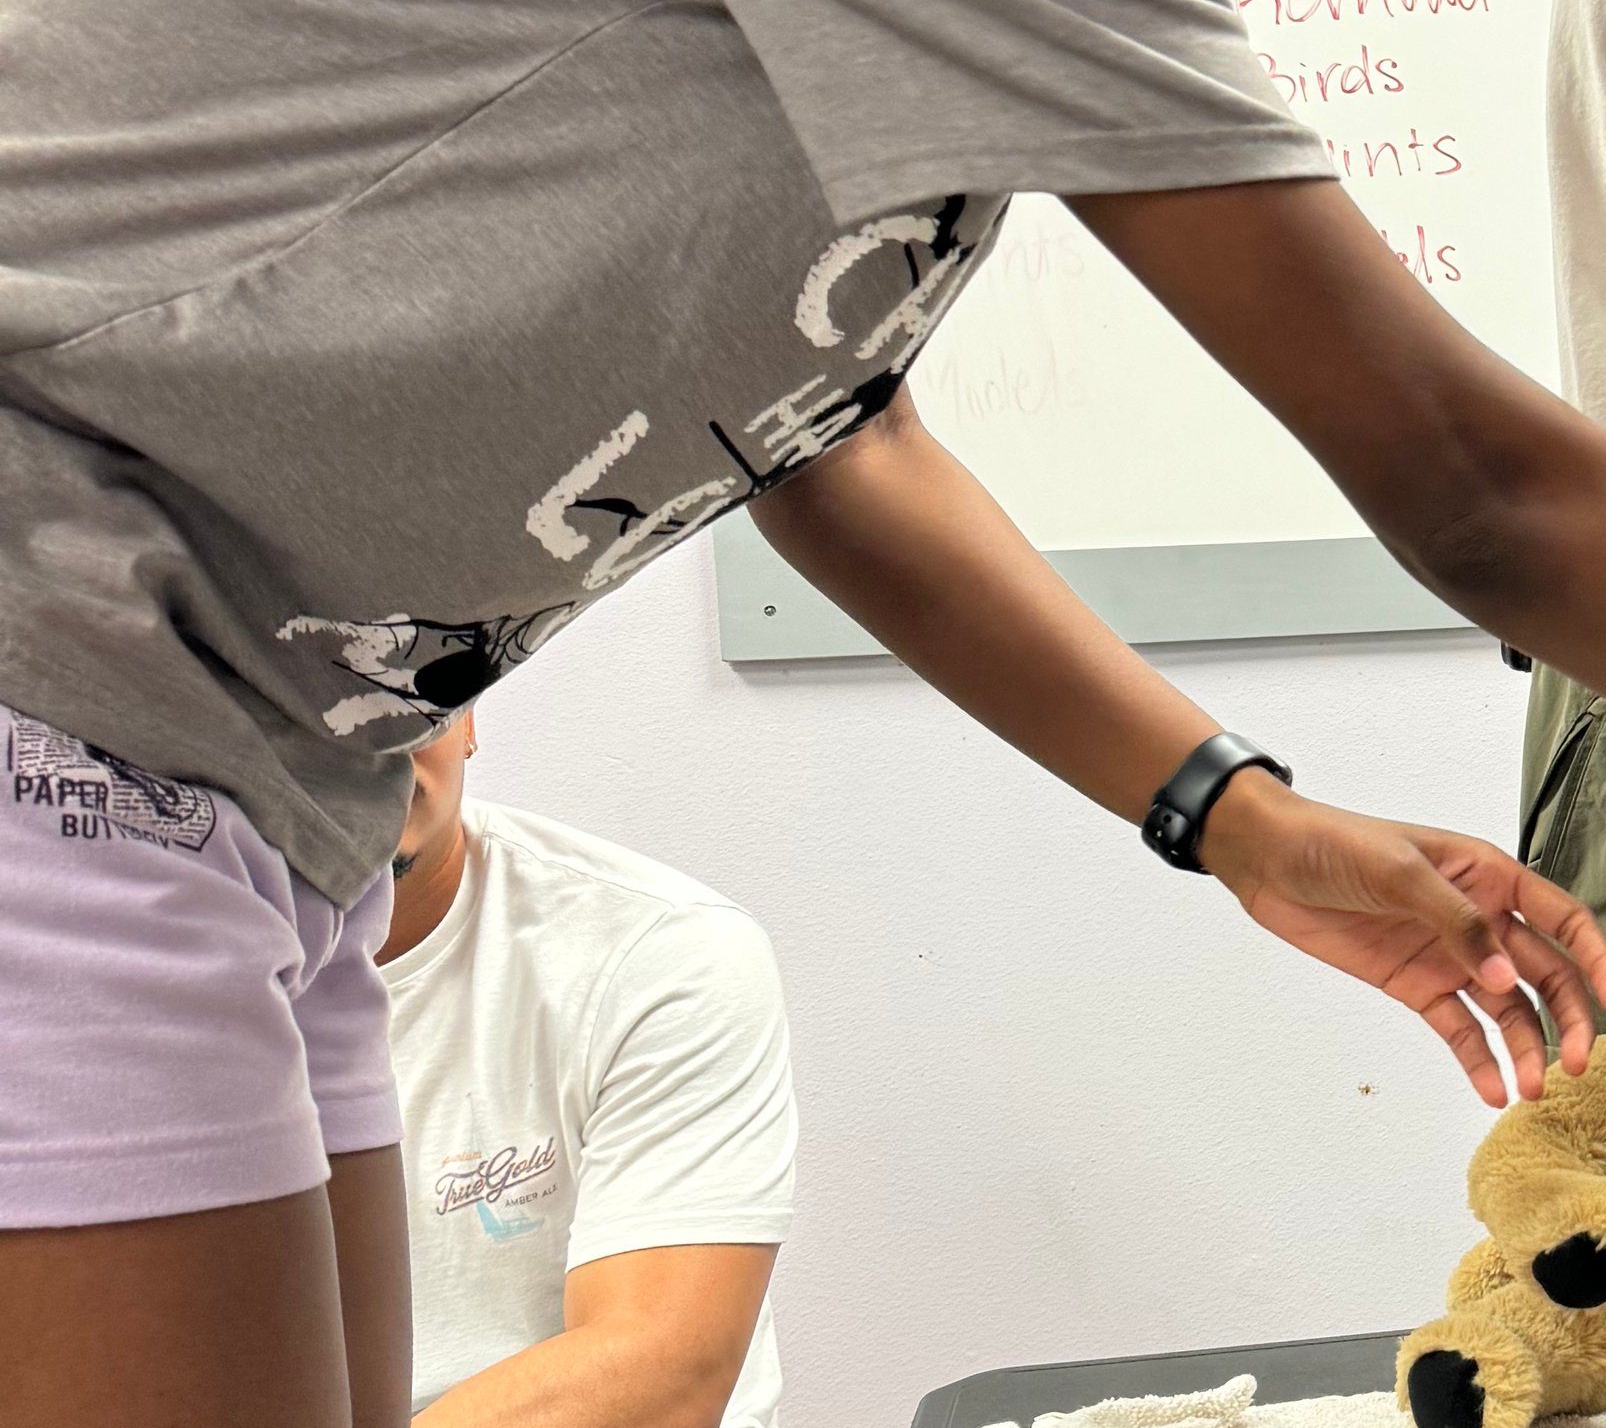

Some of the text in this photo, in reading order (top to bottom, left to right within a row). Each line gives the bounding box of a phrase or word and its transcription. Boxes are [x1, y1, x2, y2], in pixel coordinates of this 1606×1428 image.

[1256, 44, 1404, 104] Birds
[14, 775, 109, 813] PAPER
[480, 1136, 557, 1203] Gold
[505, 1184, 558, 1208] AMBER ALE
